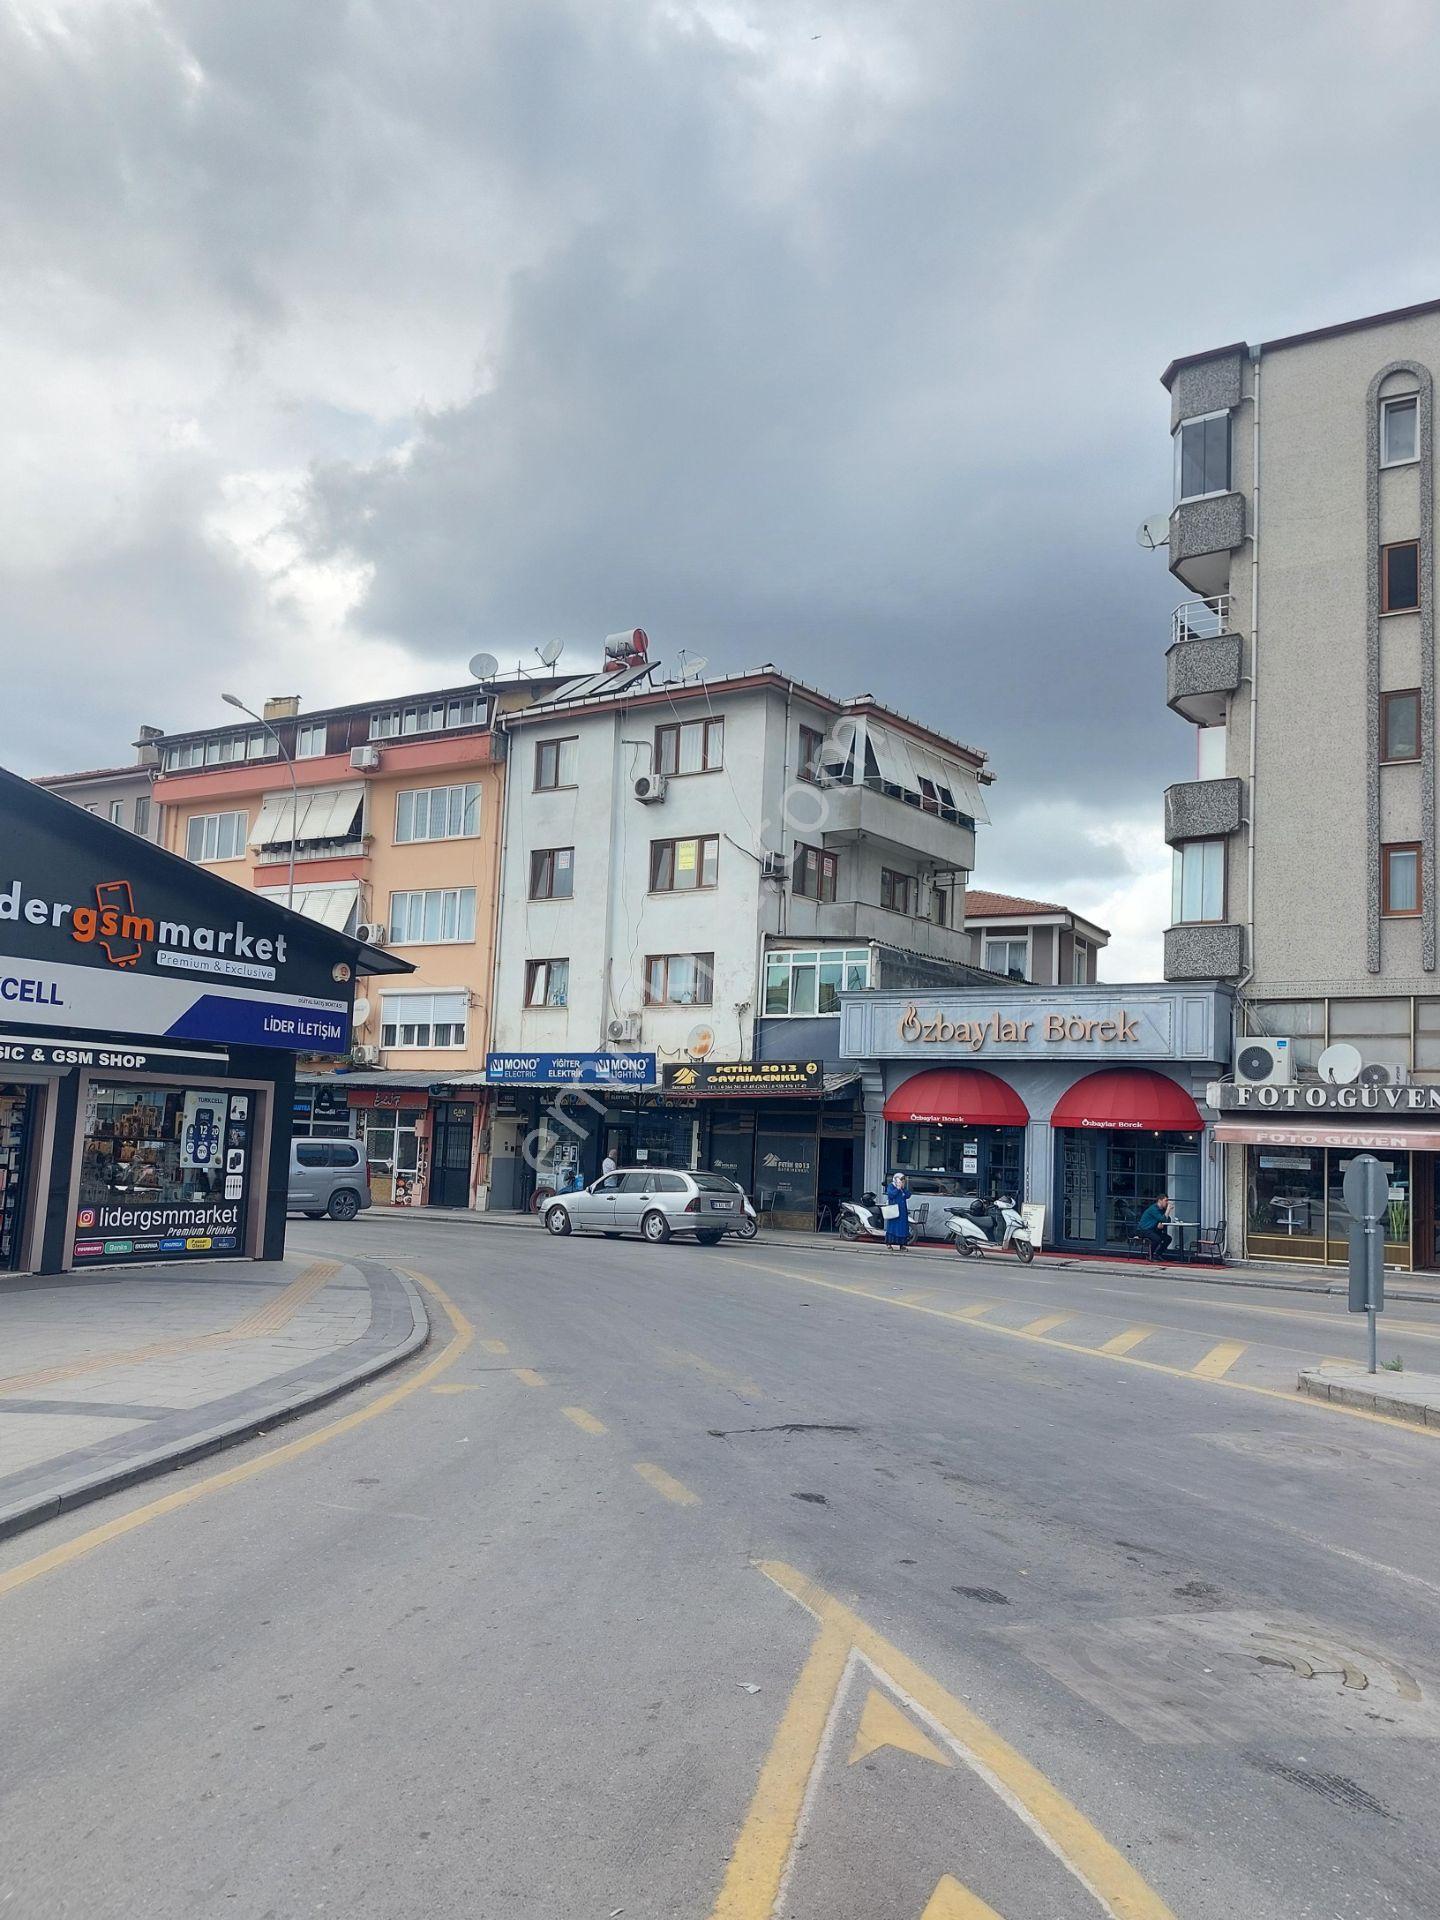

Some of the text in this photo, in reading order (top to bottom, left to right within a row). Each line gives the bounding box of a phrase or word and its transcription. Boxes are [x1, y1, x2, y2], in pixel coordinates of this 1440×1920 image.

[160, 952, 273, 979] Premium & Exclusive
[0, 977, 64, 1006] CELL
[263, 1014, 341, 1040] LİDER İLETİŞİM
[899, 1006, 1139, 1051] Özbaylar Börek
[31, 1048, 45, 1061] &
[52, 1049, 93, 1065] GSM
[99, 1053, 147, 1068] SHOP
[551, 1058, 581, 1068] YİĞİTER
[504, 1070, 537, 1078] ELECTRIC
[548, 1068, 584, 1078] ELEKTRİK
[611, 1070, 646, 1079] LIGHTING
[716, 1064, 797, 1073] FETİH 2013
[707, 1073, 807, 1083] GAYRİMENKUL
[200, 1125, 208, 1135] 12
[1255, 1132, 1408, 1147] FOTO GÜVEN
[99, 1204, 238, 1231] lidergsmmarket
[166, 1223, 237, 1237] Premium Ürünler
